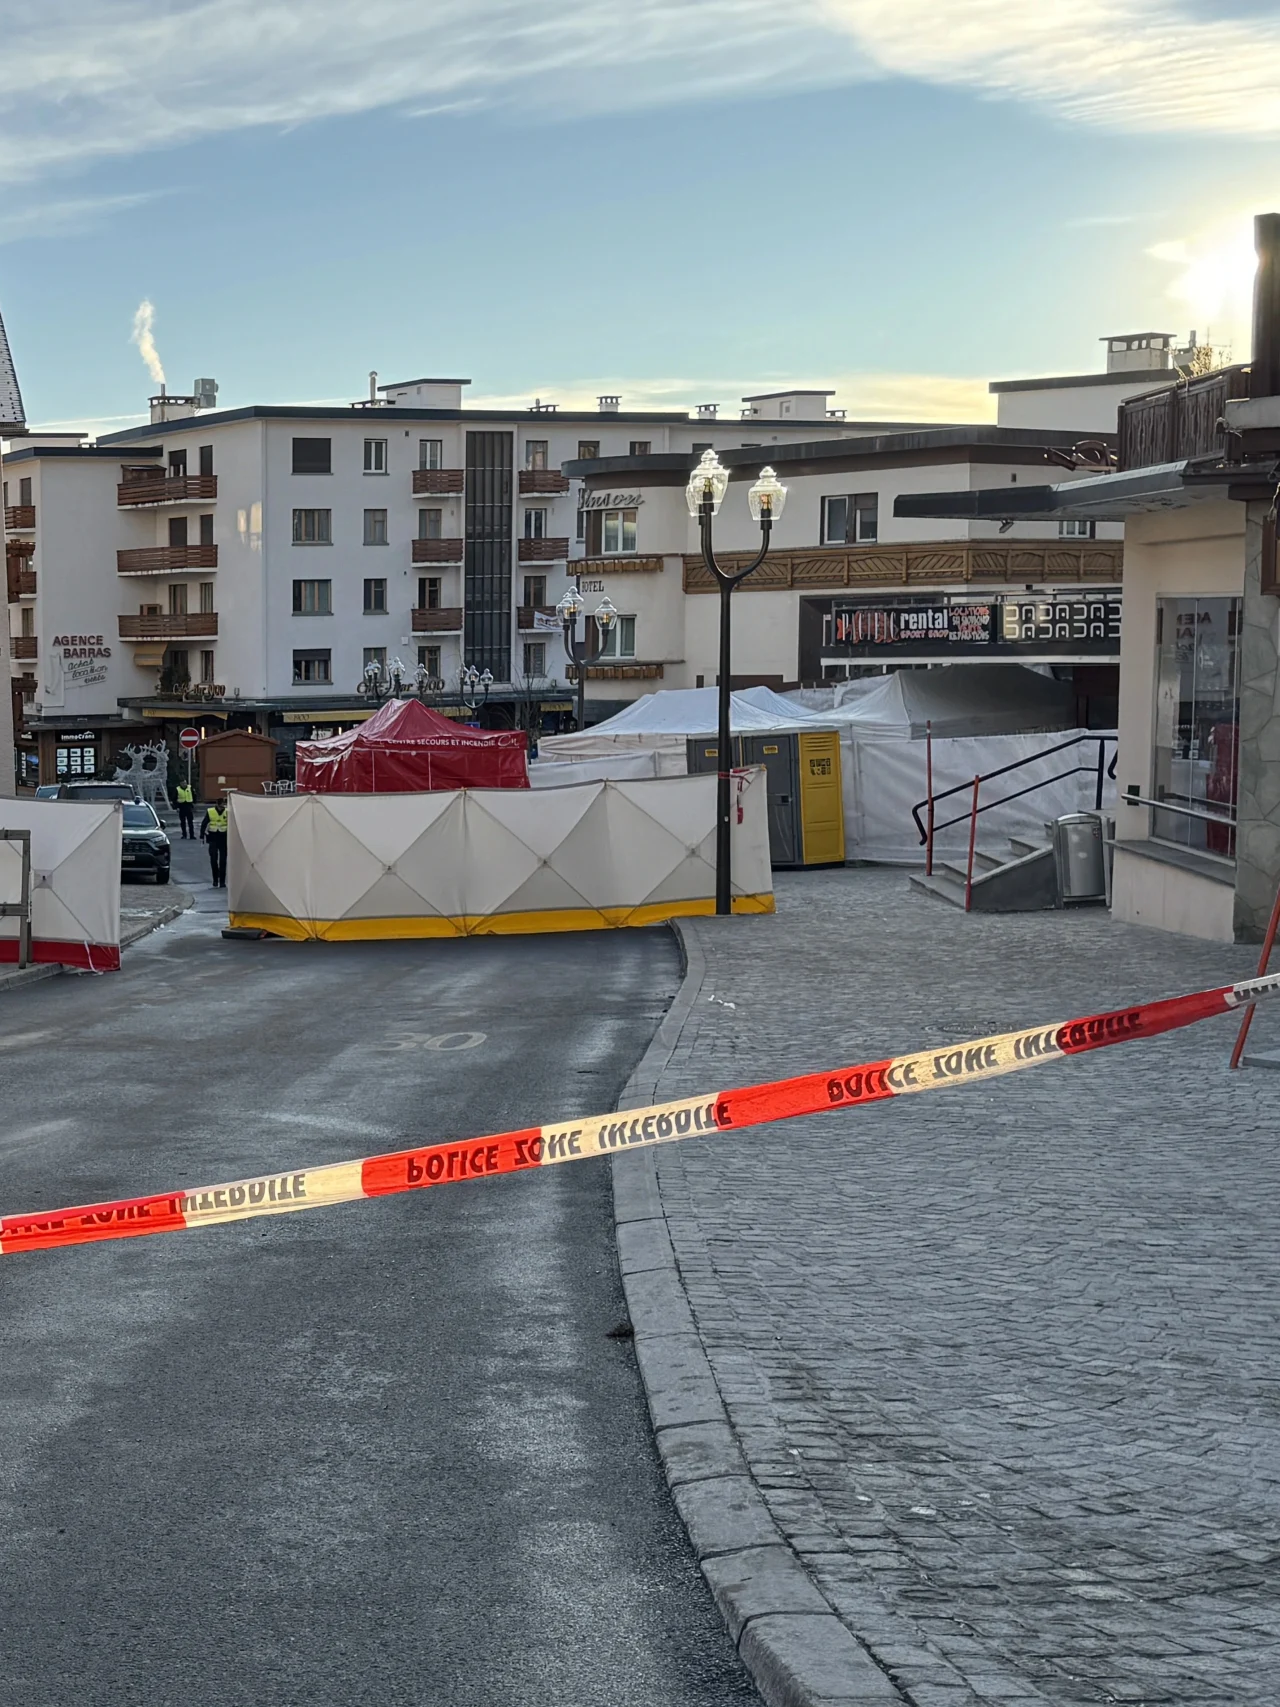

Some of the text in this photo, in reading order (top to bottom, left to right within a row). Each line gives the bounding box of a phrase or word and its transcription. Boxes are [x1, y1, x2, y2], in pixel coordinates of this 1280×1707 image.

[900, 609, 948, 630] rental
[900, 630, 926, 639] SPORT
[52, 635, 104, 648] AGENCE
[63, 647, 112, 659] BARRAS
[417, 738, 450, 746] SECOURS
[461, 739, 496, 748] INCENDIE
